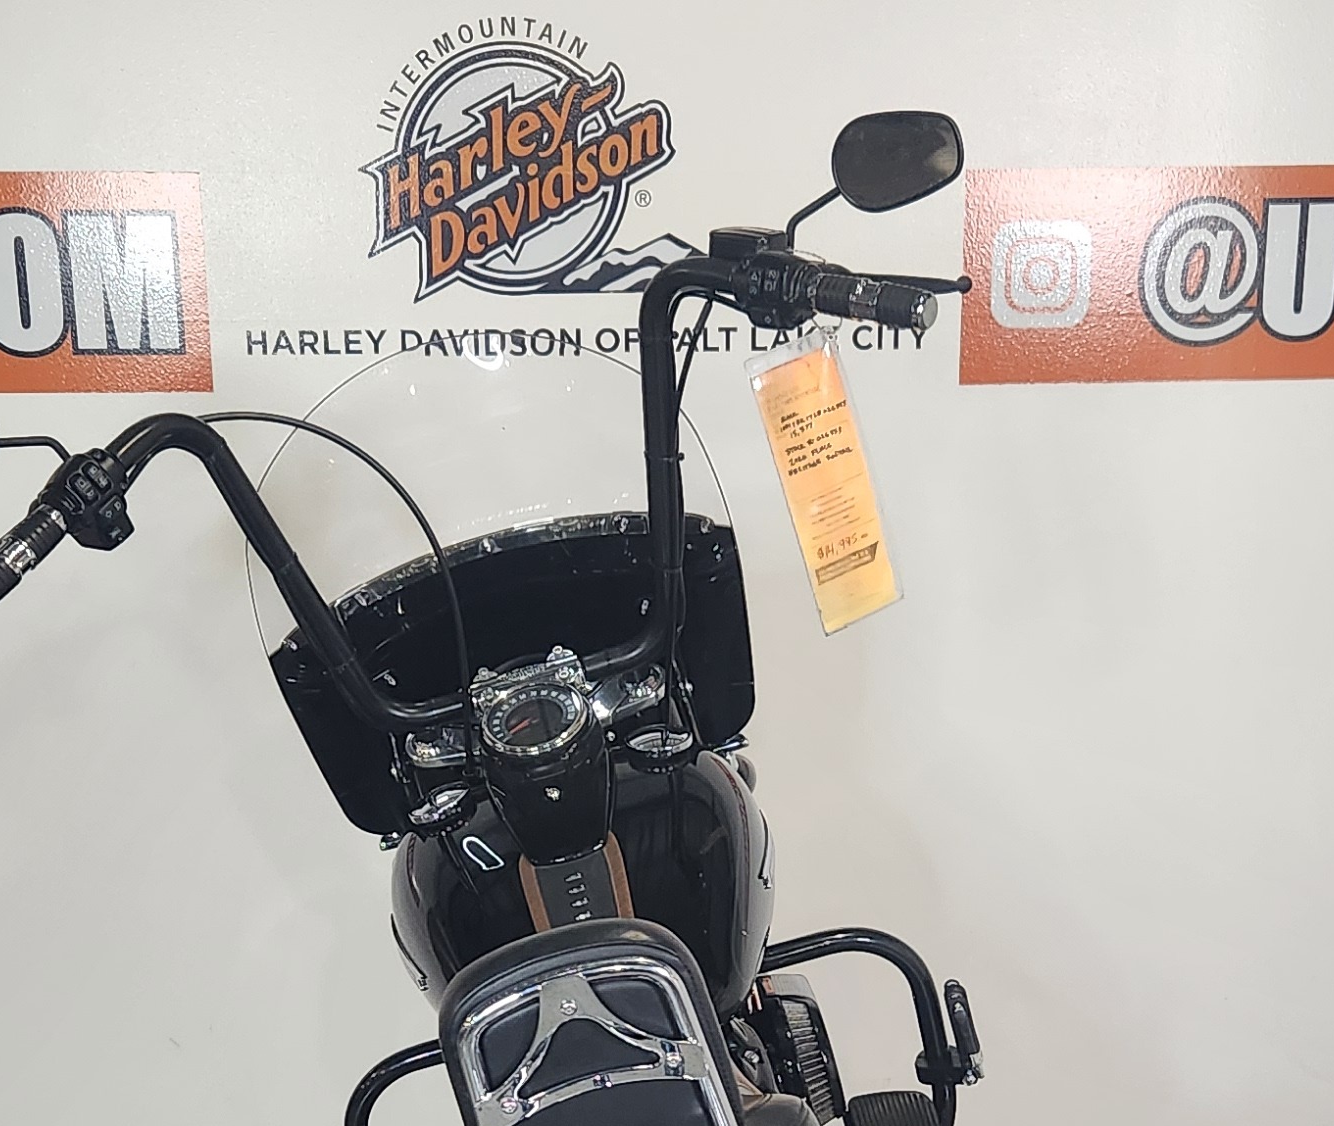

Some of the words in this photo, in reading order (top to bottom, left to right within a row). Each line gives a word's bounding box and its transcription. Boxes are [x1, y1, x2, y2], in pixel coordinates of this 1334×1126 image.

[377, 16, 589, 133] INTERMOUNTAIN
[429, 113, 659, 278] Davidson
[245, 328, 387, 356] HARLEY
[400, 327, 582, 357] DAVIDSON
[595, 327, 641, 354] OF
[675, 326, 738, 352] ALT
[750, 326, 839, 352] LAK
[852, 324, 925, 350] CITY
